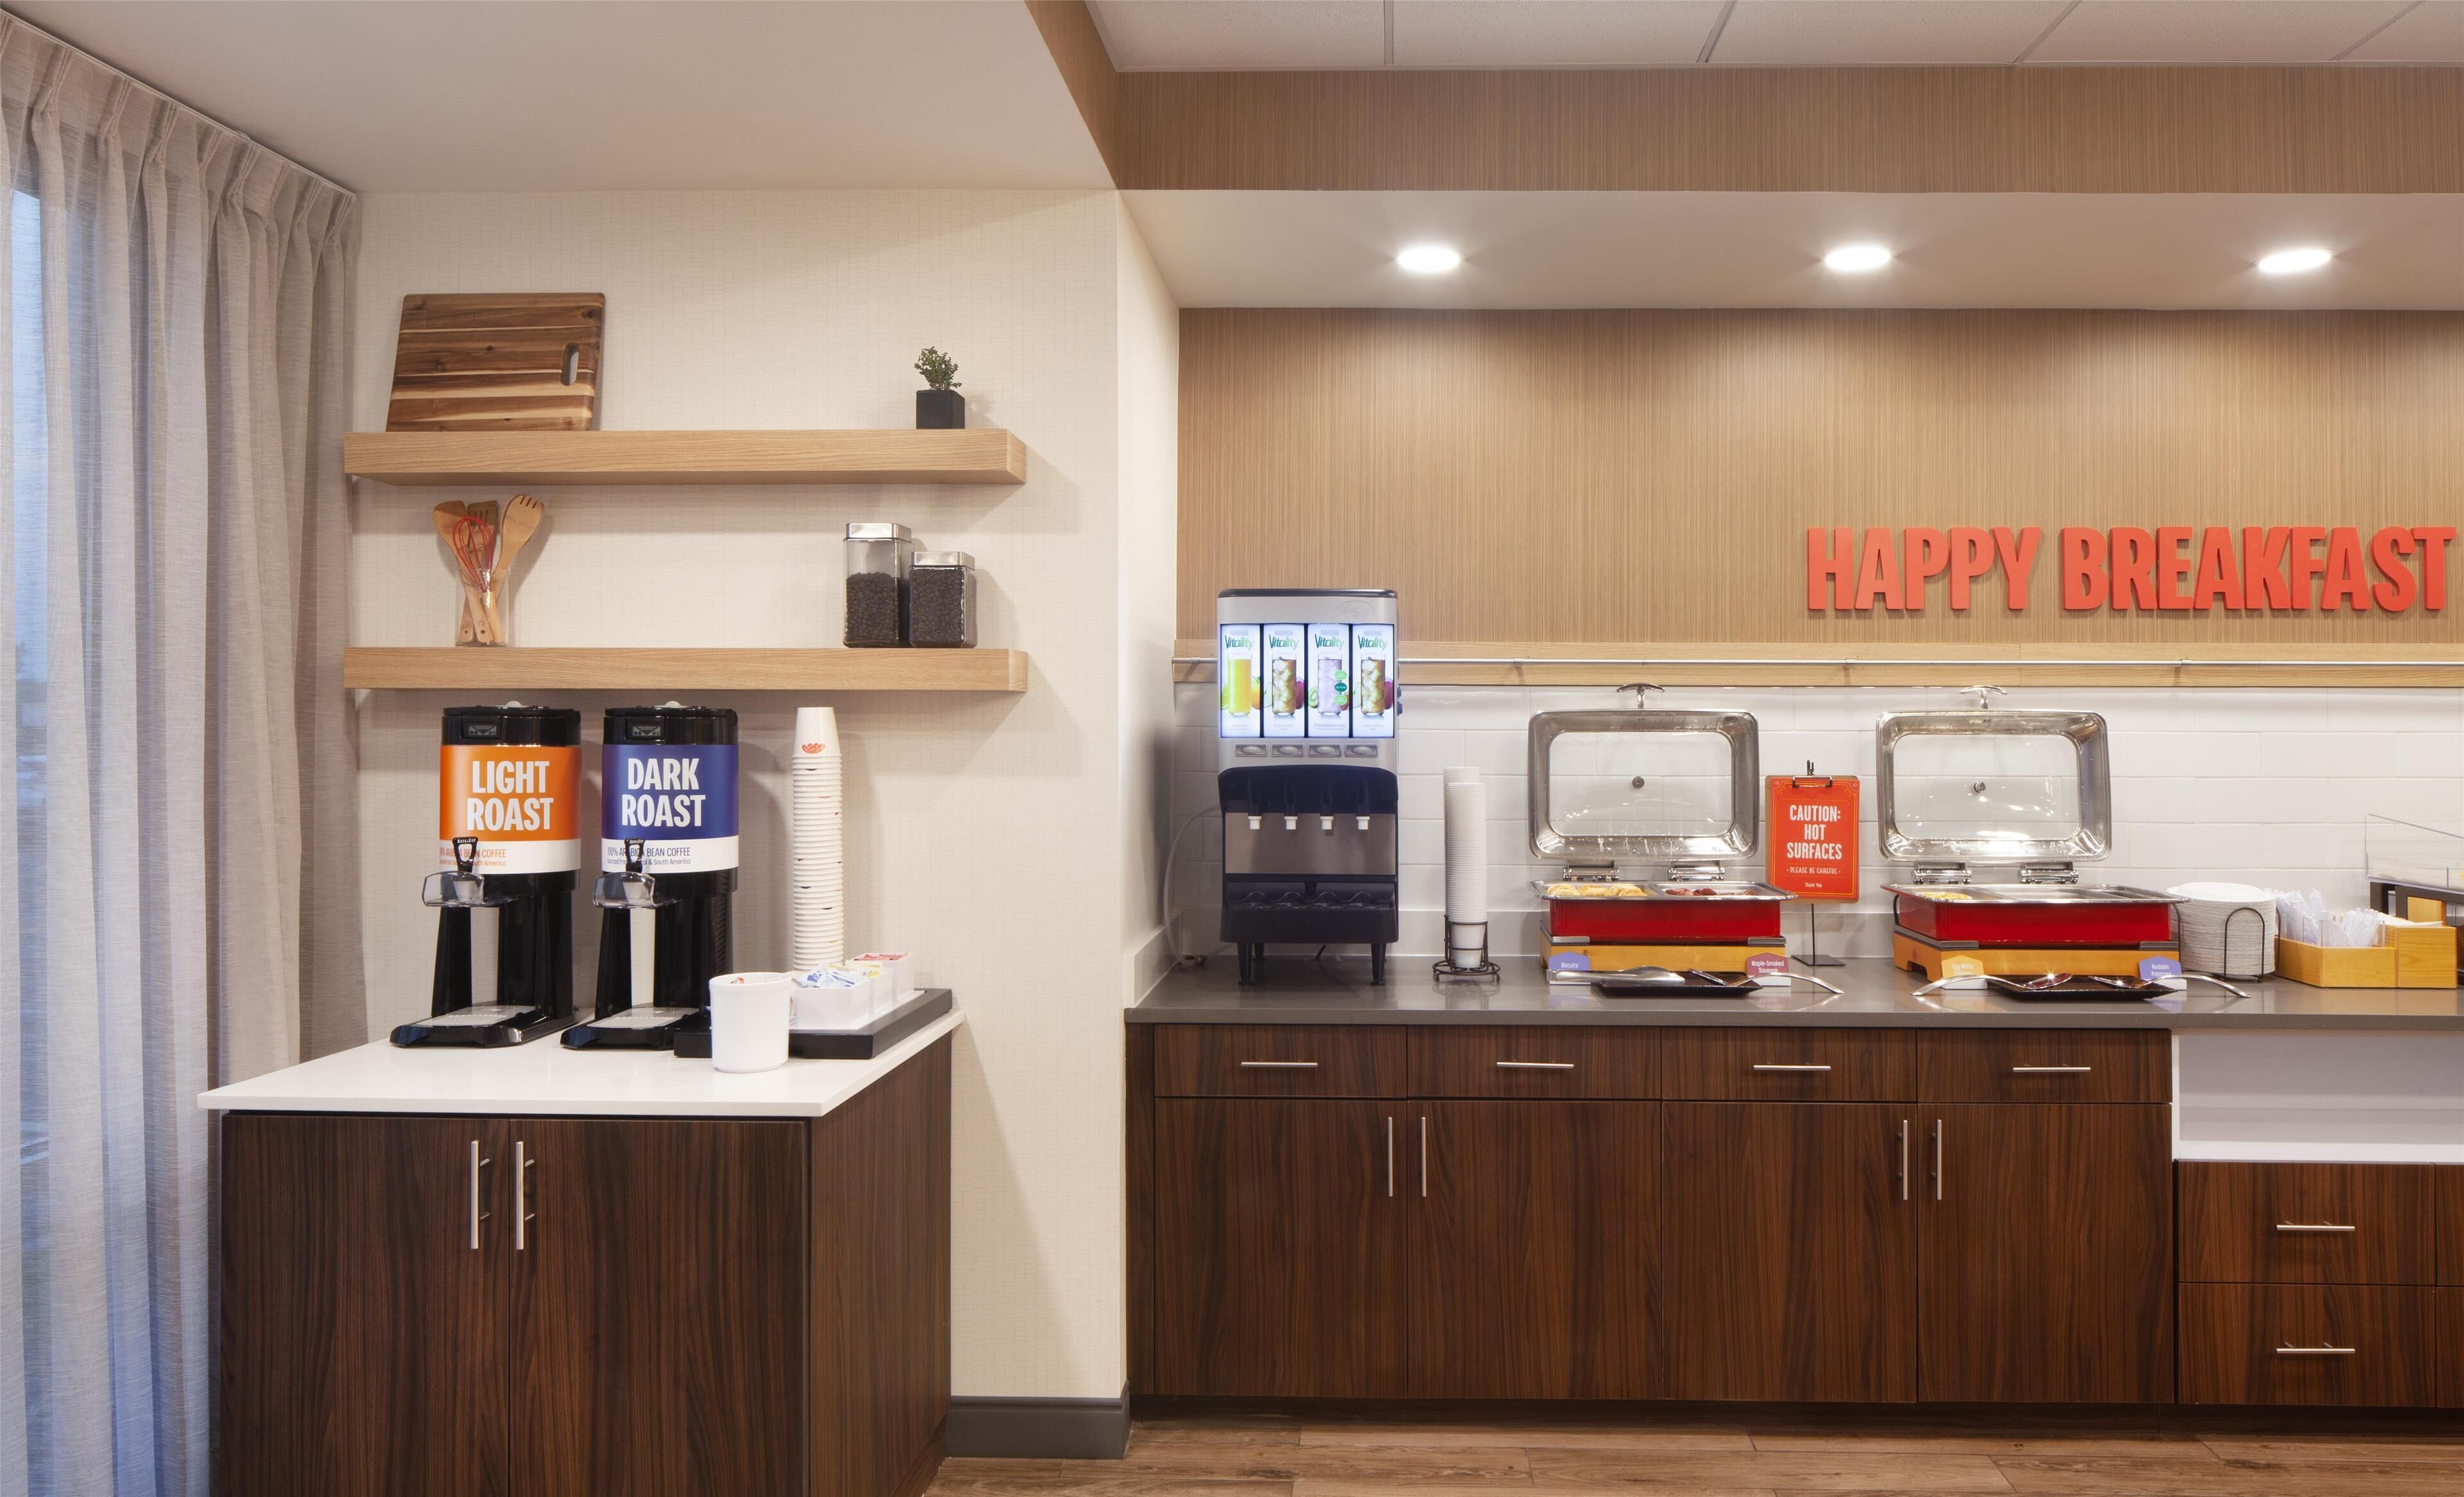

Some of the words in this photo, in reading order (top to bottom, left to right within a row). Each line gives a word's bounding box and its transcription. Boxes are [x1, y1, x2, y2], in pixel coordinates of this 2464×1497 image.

[1808, 527, 2042, 610] HAPPY
[2062, 527, 2456, 611] BREAKFAST
[1225, 634, 1254, 651] Vitality
[1269, 634, 1299, 651] Vitality
[1315, 633, 1344, 650] Vitality
[1358, 634, 1388, 651] Vitality
[472, 761, 549, 793] LIGHT
[628, 758, 699, 790] DARK
[466, 798, 554, 830] ROAST
[622, 794, 706, 827] ROAST
[1790, 805, 1841, 822] CAUTION:
[1804, 824, 1826, 841] HOT
[464, 848, 480, 857] BEN
[482, 849, 506, 858] COFFEE
[619, 847, 645, 856] ARBIC
[647, 848, 665, 857] BEAN
[667, 847, 691, 857] COFFEE
[1787, 843, 1842, 859] SURFACES
